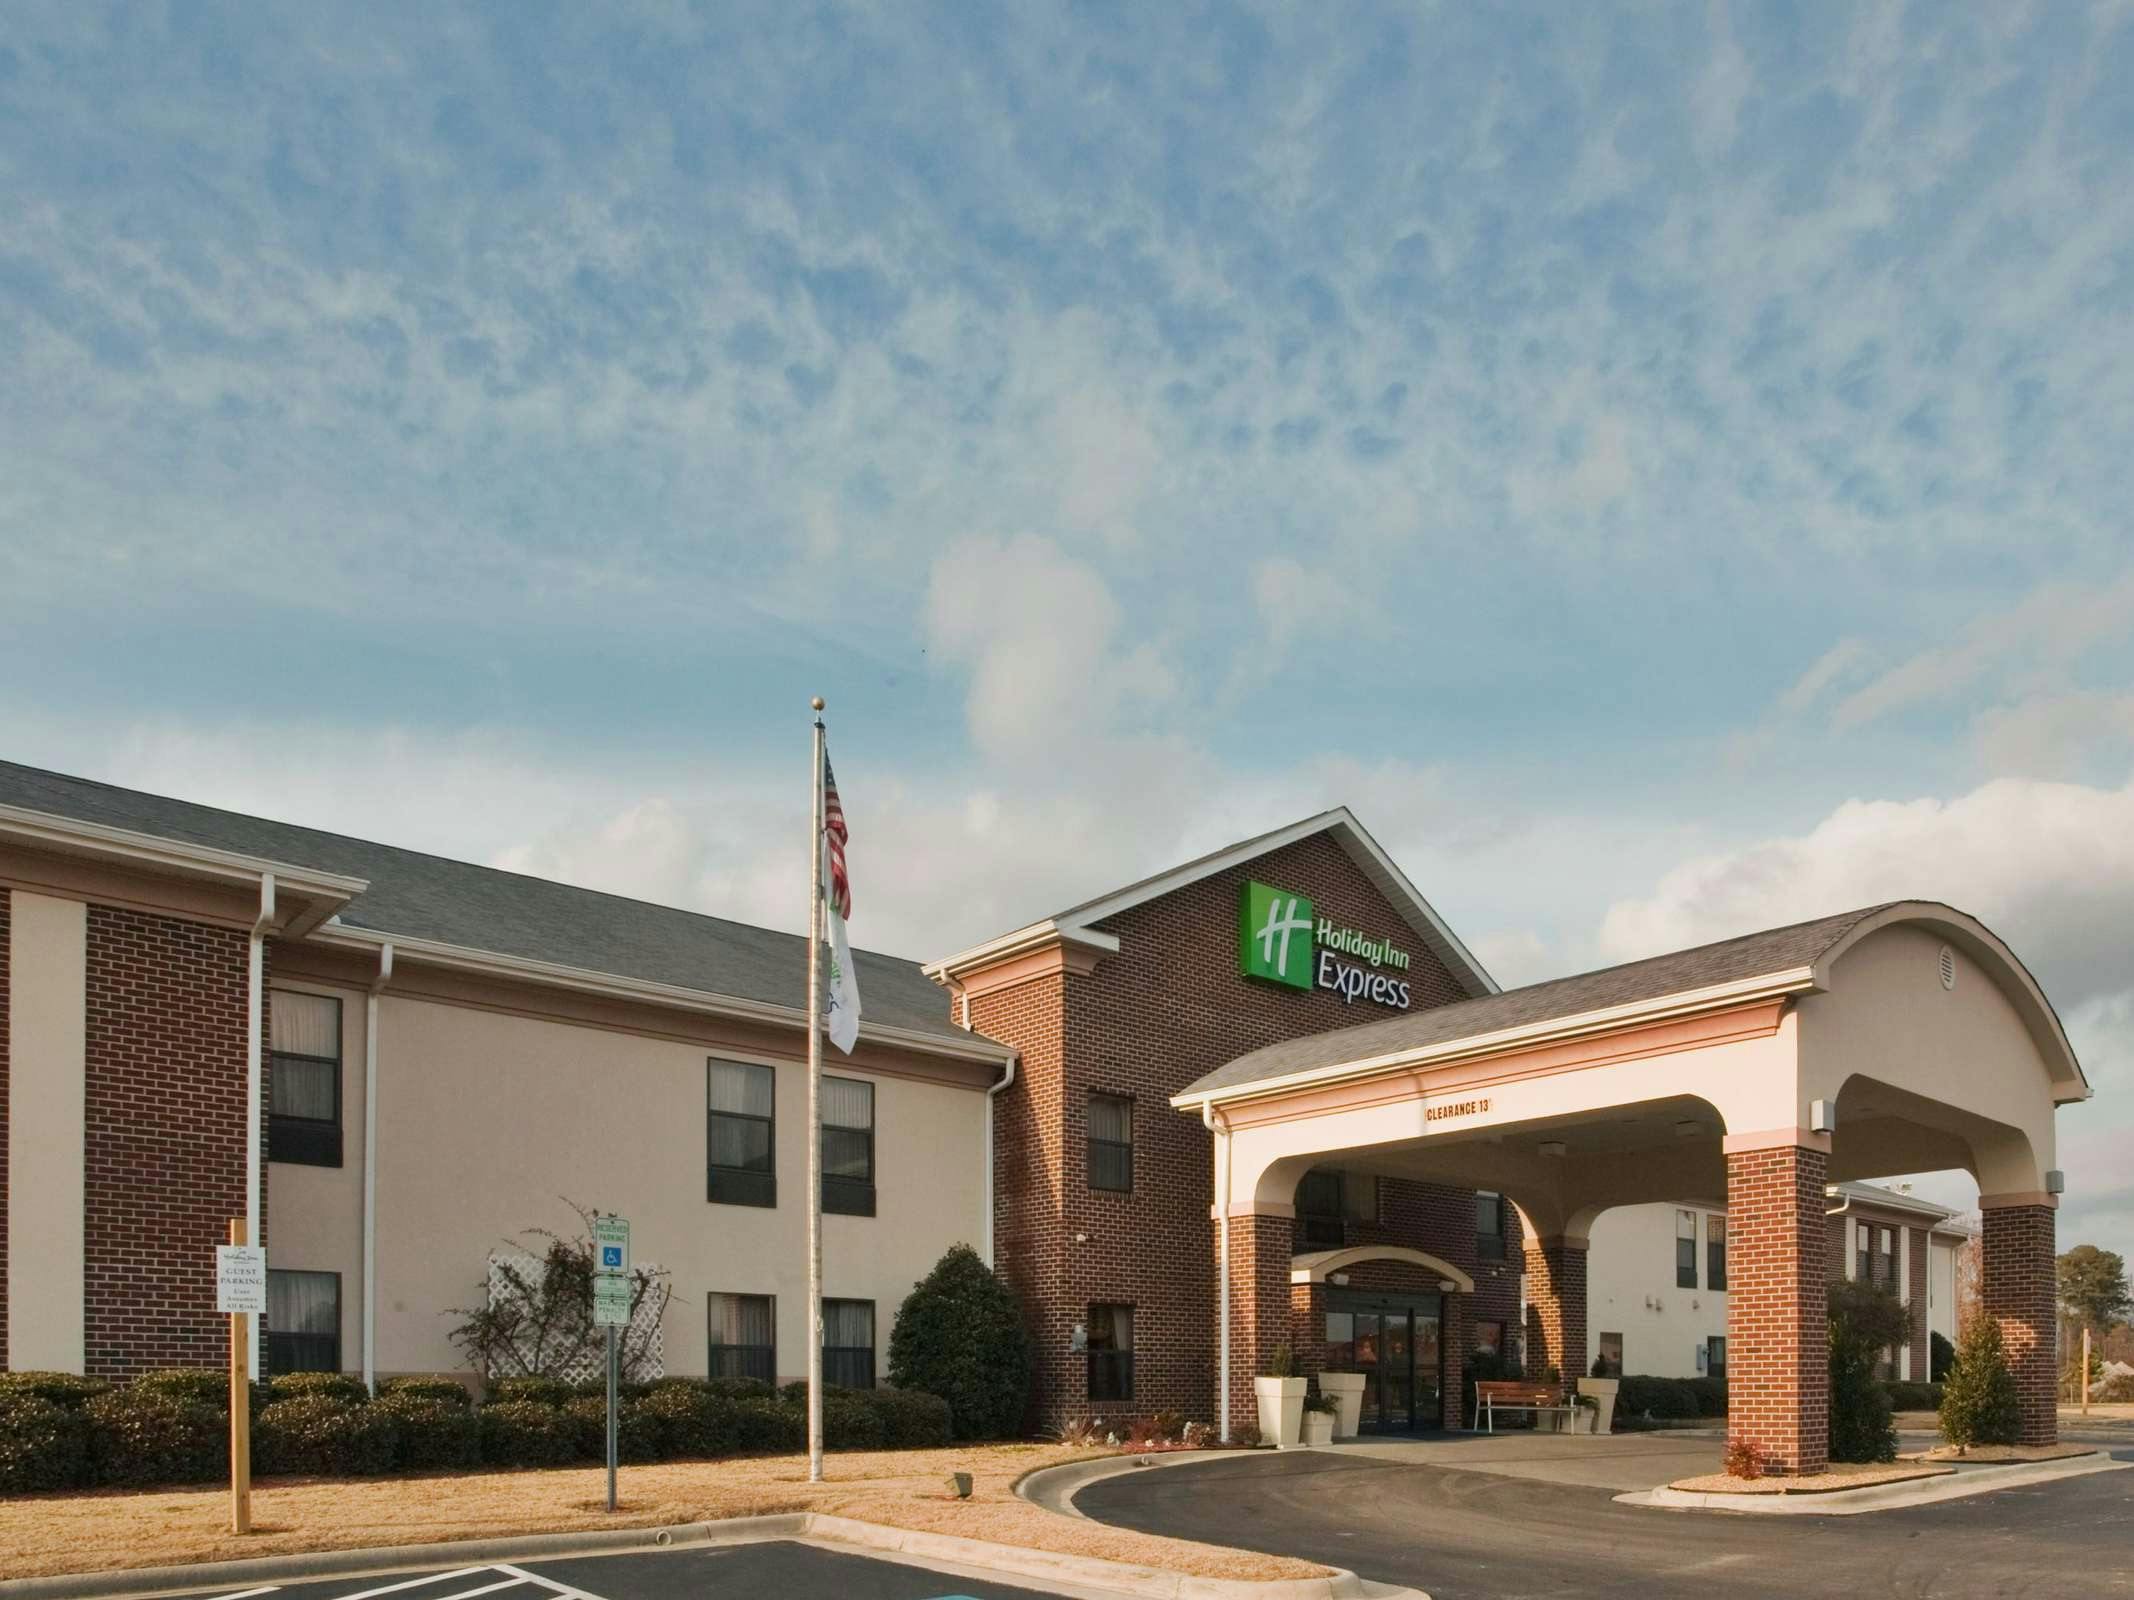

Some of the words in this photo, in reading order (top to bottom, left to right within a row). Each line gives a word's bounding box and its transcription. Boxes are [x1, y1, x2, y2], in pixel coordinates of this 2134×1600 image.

[1317, 917, 1383, 967] Holiday
[1385, 939, 1410, 970] Inn
[1318, 950, 1411, 1009] Express
[1426, 1101, 1477, 1121] CLEARANCE
[599, 1233, 626, 1242] PARKING
[220, 1277, 263, 1286] PARKING
